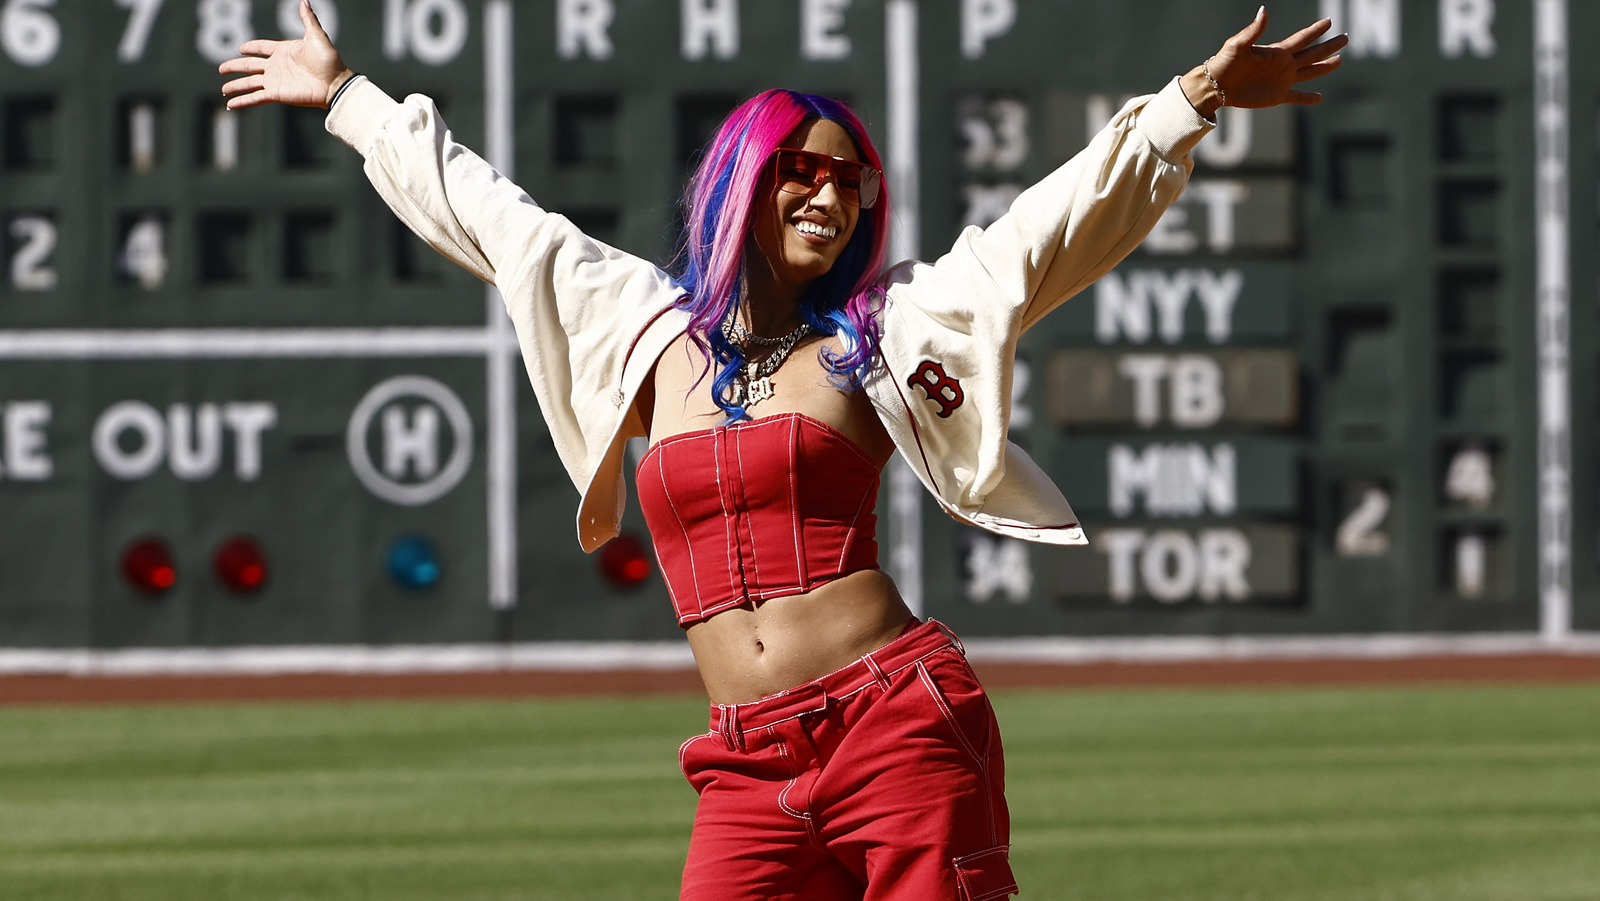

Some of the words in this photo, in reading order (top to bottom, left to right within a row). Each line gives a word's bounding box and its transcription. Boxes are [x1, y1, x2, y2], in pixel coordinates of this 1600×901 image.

[2, 0, 61, 66] 6
[115, 0, 163, 63] 7
[197, 0, 254, 64] 8
[384, 0, 468, 65] 10
[556, 0, 614, 60] R
[681, 0, 740, 60] H
[803, 0, 852, 60] E
[961, 0, 1017, 58] P
[1438, 0, 1497, 58] R
[10, 215, 57, 290] 2
[121, 218, 167, 288] 4
[1094, 270, 1243, 342] NYY
[907, 360, 964, 418] B
[1119, 355, 1226, 428] TB
[92, 401, 277, 480] OUT
[381, 406, 440, 478] H
[1107, 443, 1238, 517] MIN
[1337, 488, 1389, 556] 2
[1097, 528, 1251, 602] TOR
